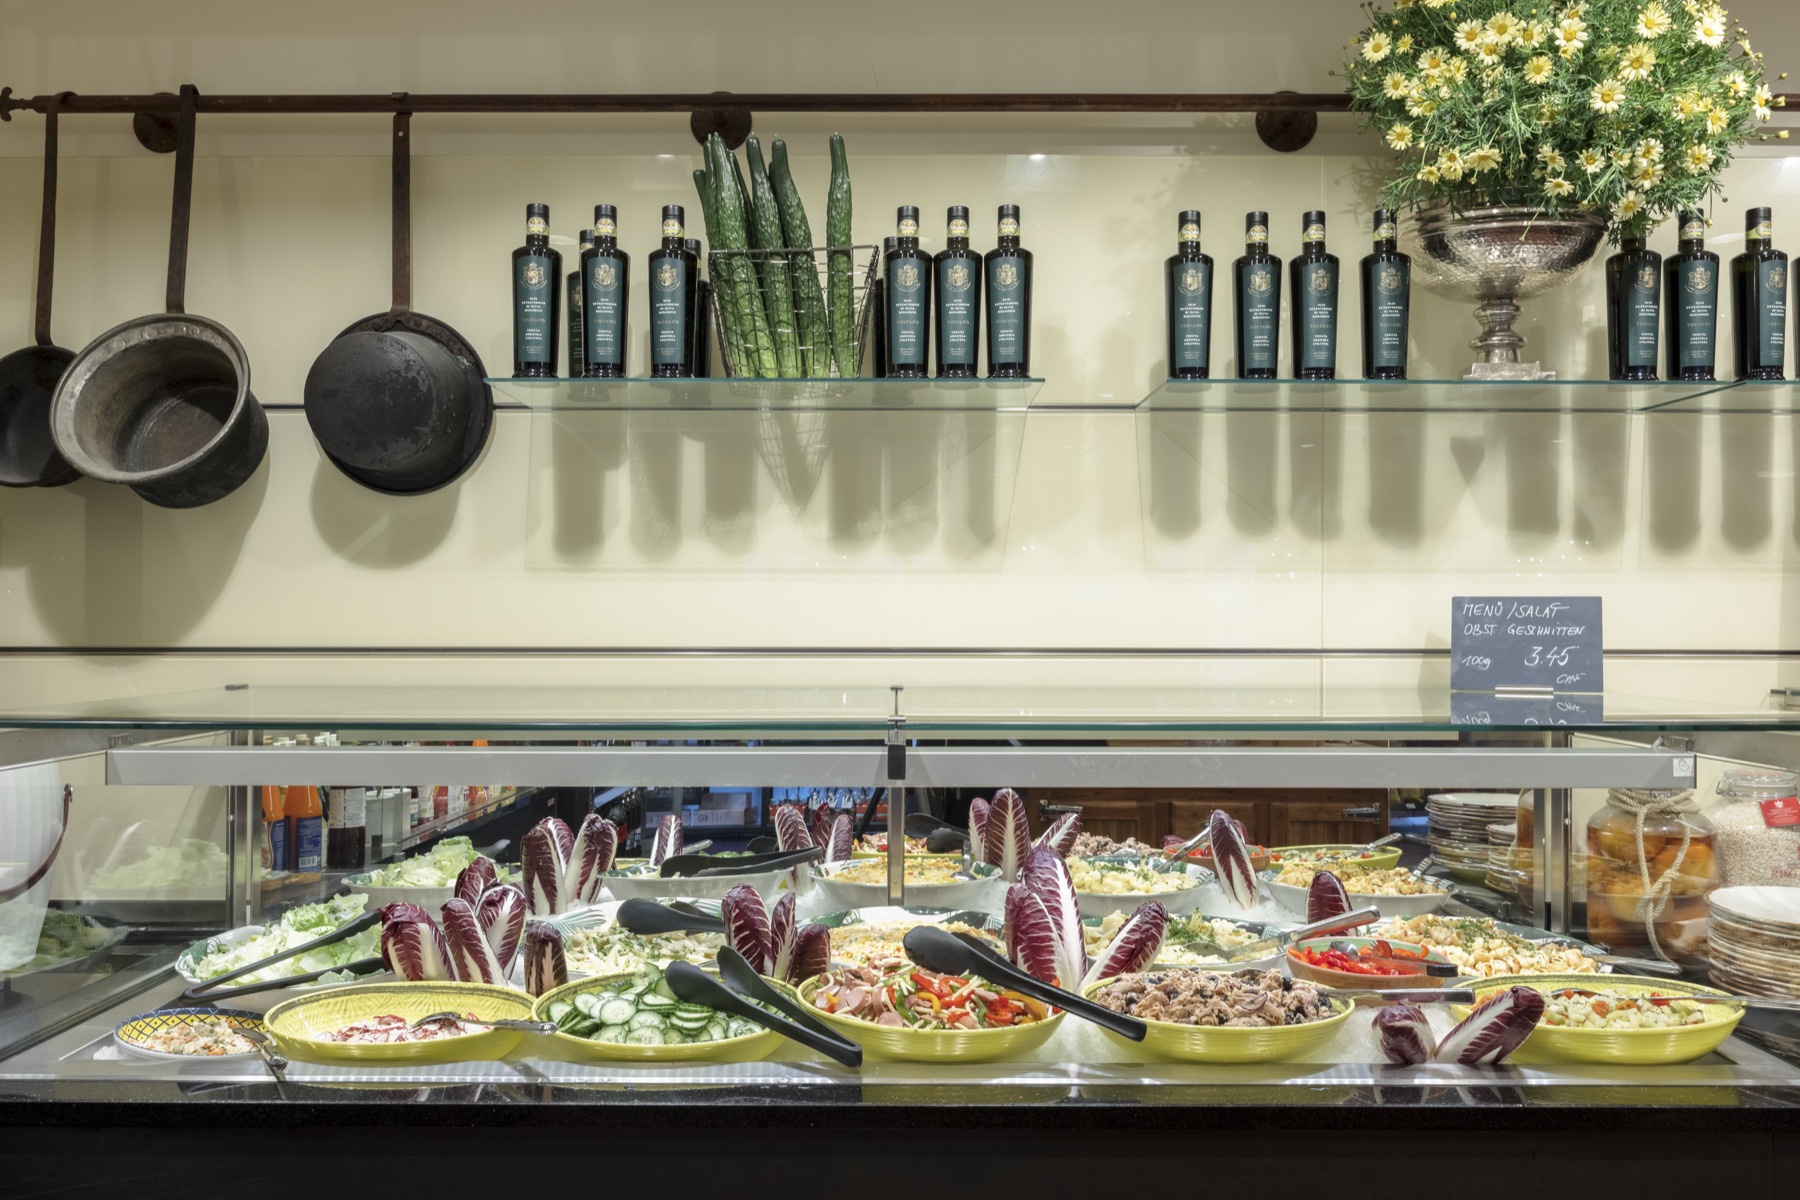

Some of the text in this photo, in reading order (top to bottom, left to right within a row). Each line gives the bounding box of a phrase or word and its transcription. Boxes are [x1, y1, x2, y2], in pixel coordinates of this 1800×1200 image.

[1462, 601, 1504, 617] MENÜ
[1464, 622, 1586, 636] OBST GESCHNITTEN
[1462, 646, 1580, 670] 100g 3.45
